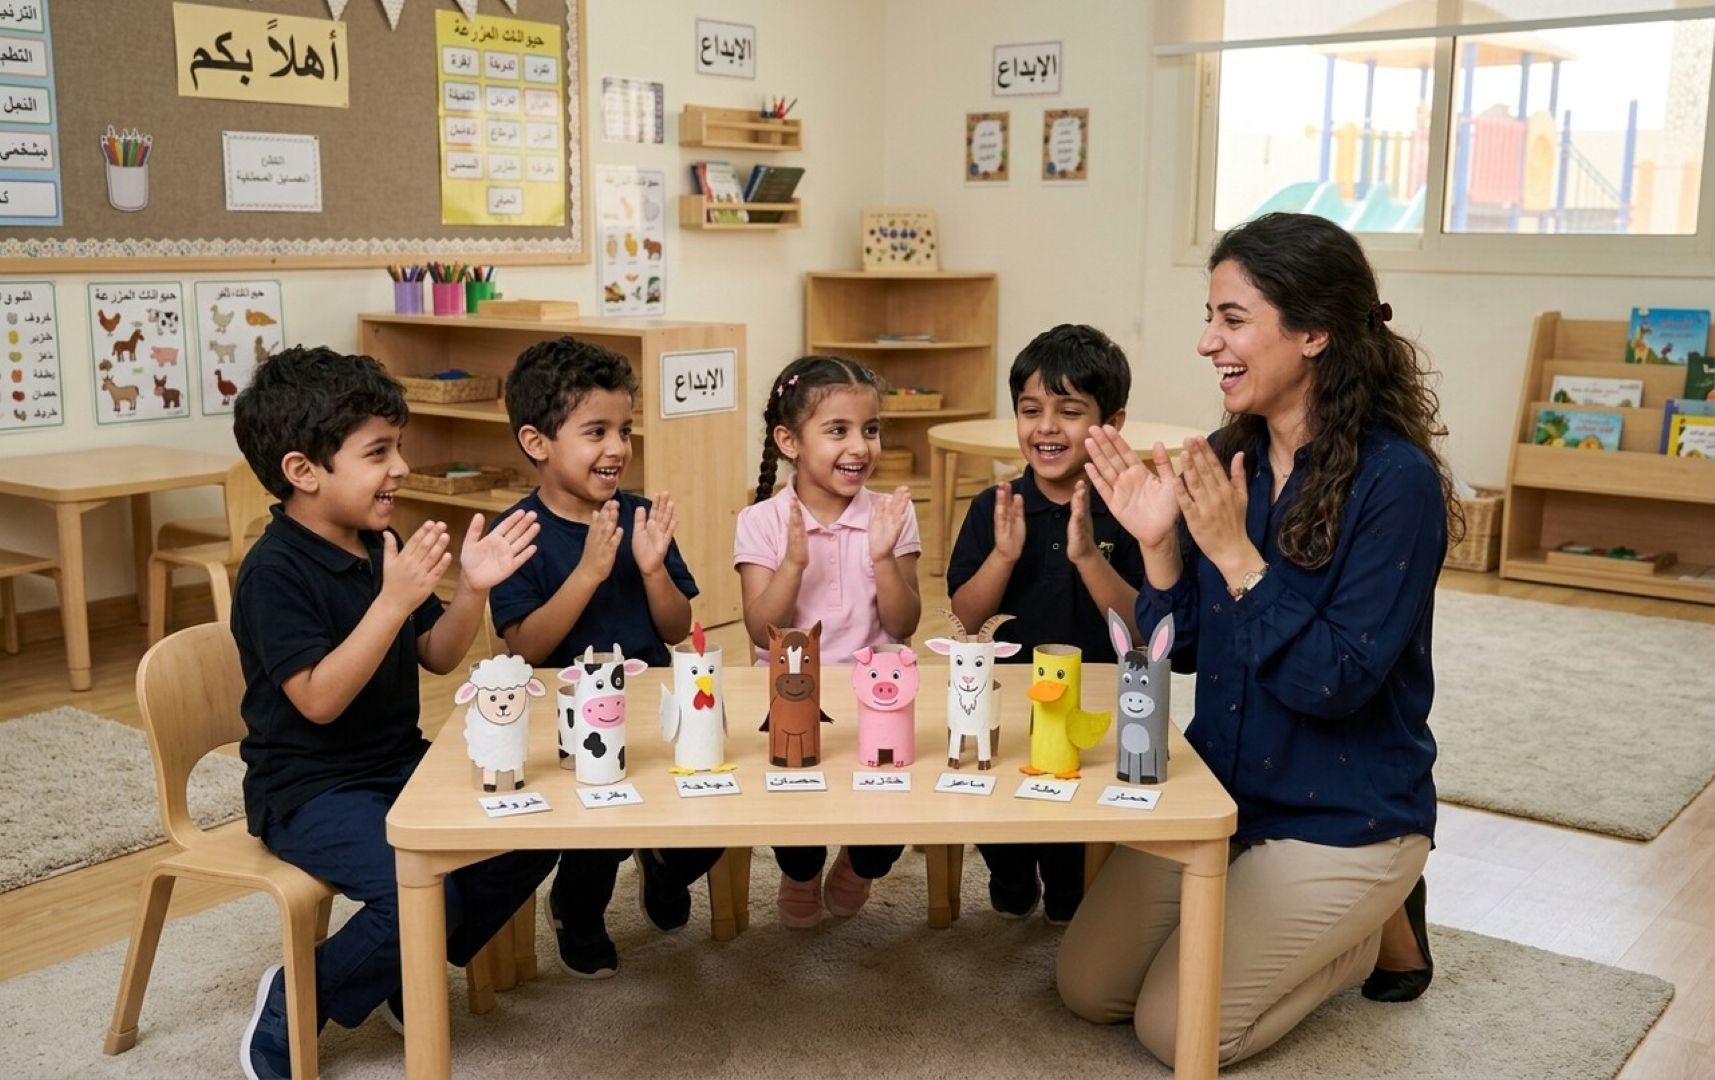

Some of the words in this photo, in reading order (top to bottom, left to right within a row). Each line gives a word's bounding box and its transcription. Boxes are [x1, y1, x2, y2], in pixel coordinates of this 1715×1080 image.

[190, 32, 253, 90] بكم
[267, 19, 339, 82] أهلاً
[700, 34, 751, 67] الإبداع
[997, 54, 1057, 89] الإبداع
[674, 367, 724, 403] الإبداع
